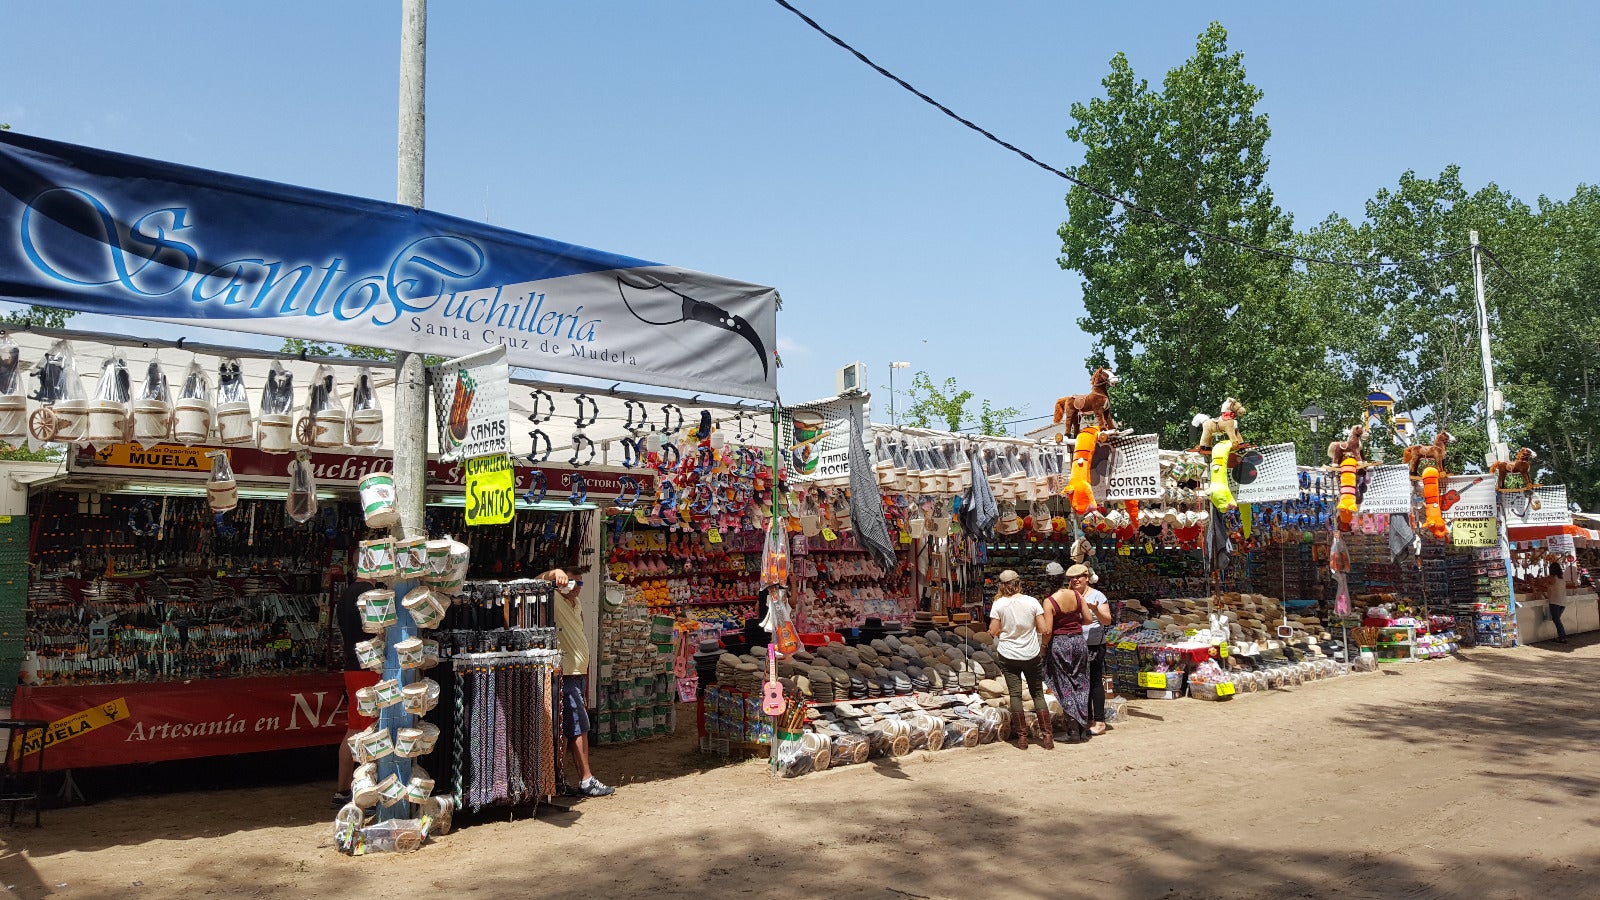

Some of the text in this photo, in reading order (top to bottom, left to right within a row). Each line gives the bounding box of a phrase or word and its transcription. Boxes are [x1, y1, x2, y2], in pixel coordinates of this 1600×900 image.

[411, 317, 637, 366] Santa Cruz de Mudela
[470, 418, 506, 441] CAÑAS
[129, 452, 199, 468] MUELA
[1109, 476, 1157, 488] GORRAS
[467, 480, 513, 520] SANTOS
[1105, 487, 1157, 498] ROCIERAS
[1372, 506, 1408, 514] SOMBREROS
[1453, 510, 1494, 518] ROCIERAS
[1469, 529, 1477, 539] 5
[123, 691, 350, 743] Artesanía en NA
[23, 719, 93, 753] MUELA
